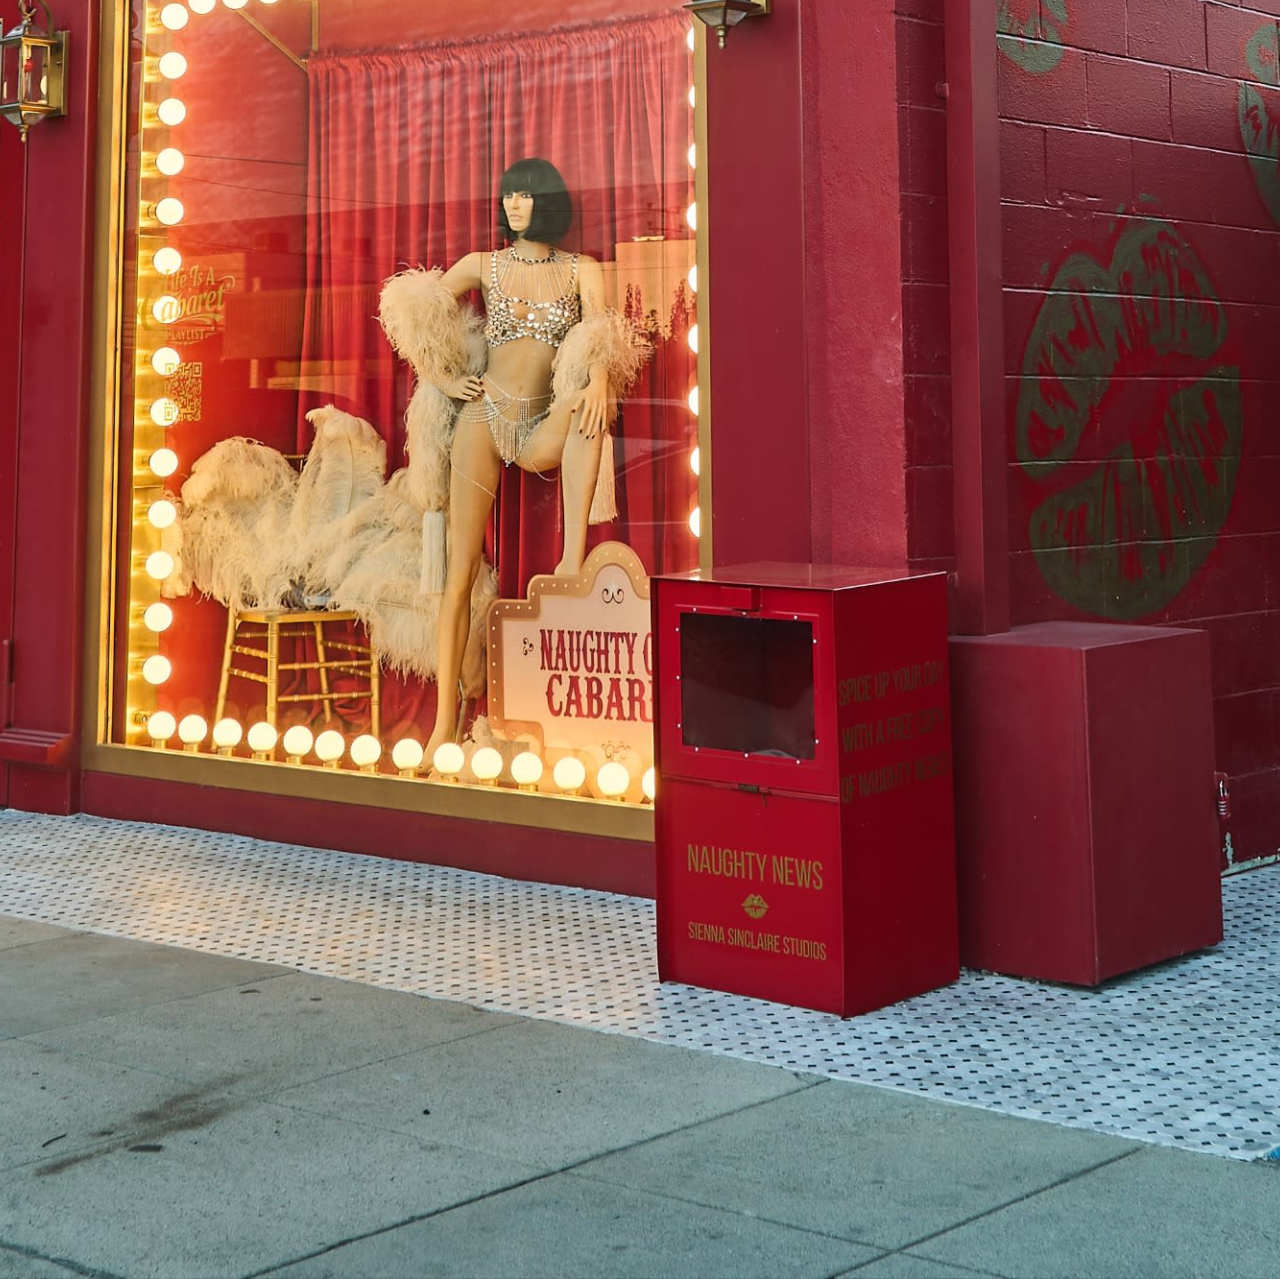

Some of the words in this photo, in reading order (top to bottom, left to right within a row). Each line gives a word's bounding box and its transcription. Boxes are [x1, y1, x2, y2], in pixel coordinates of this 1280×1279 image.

[539, 629, 638, 675] NAUGHTY
[546, 673, 653, 722] CABAR
[839, 673, 872, 706] SPICE
[874, 671, 890, 698] UP
[842, 721, 873, 753] WITH
[875, 719, 885, 745] A
[840, 774, 856, 805] OF
[687, 843, 768, 882] NAUGHTY
[772, 854, 824, 891] NEWS
[688, 921, 726, 945] SIENNA
[727, 927, 780, 954] SINCLAIRE
[782, 935, 827, 961] STUDIOS
